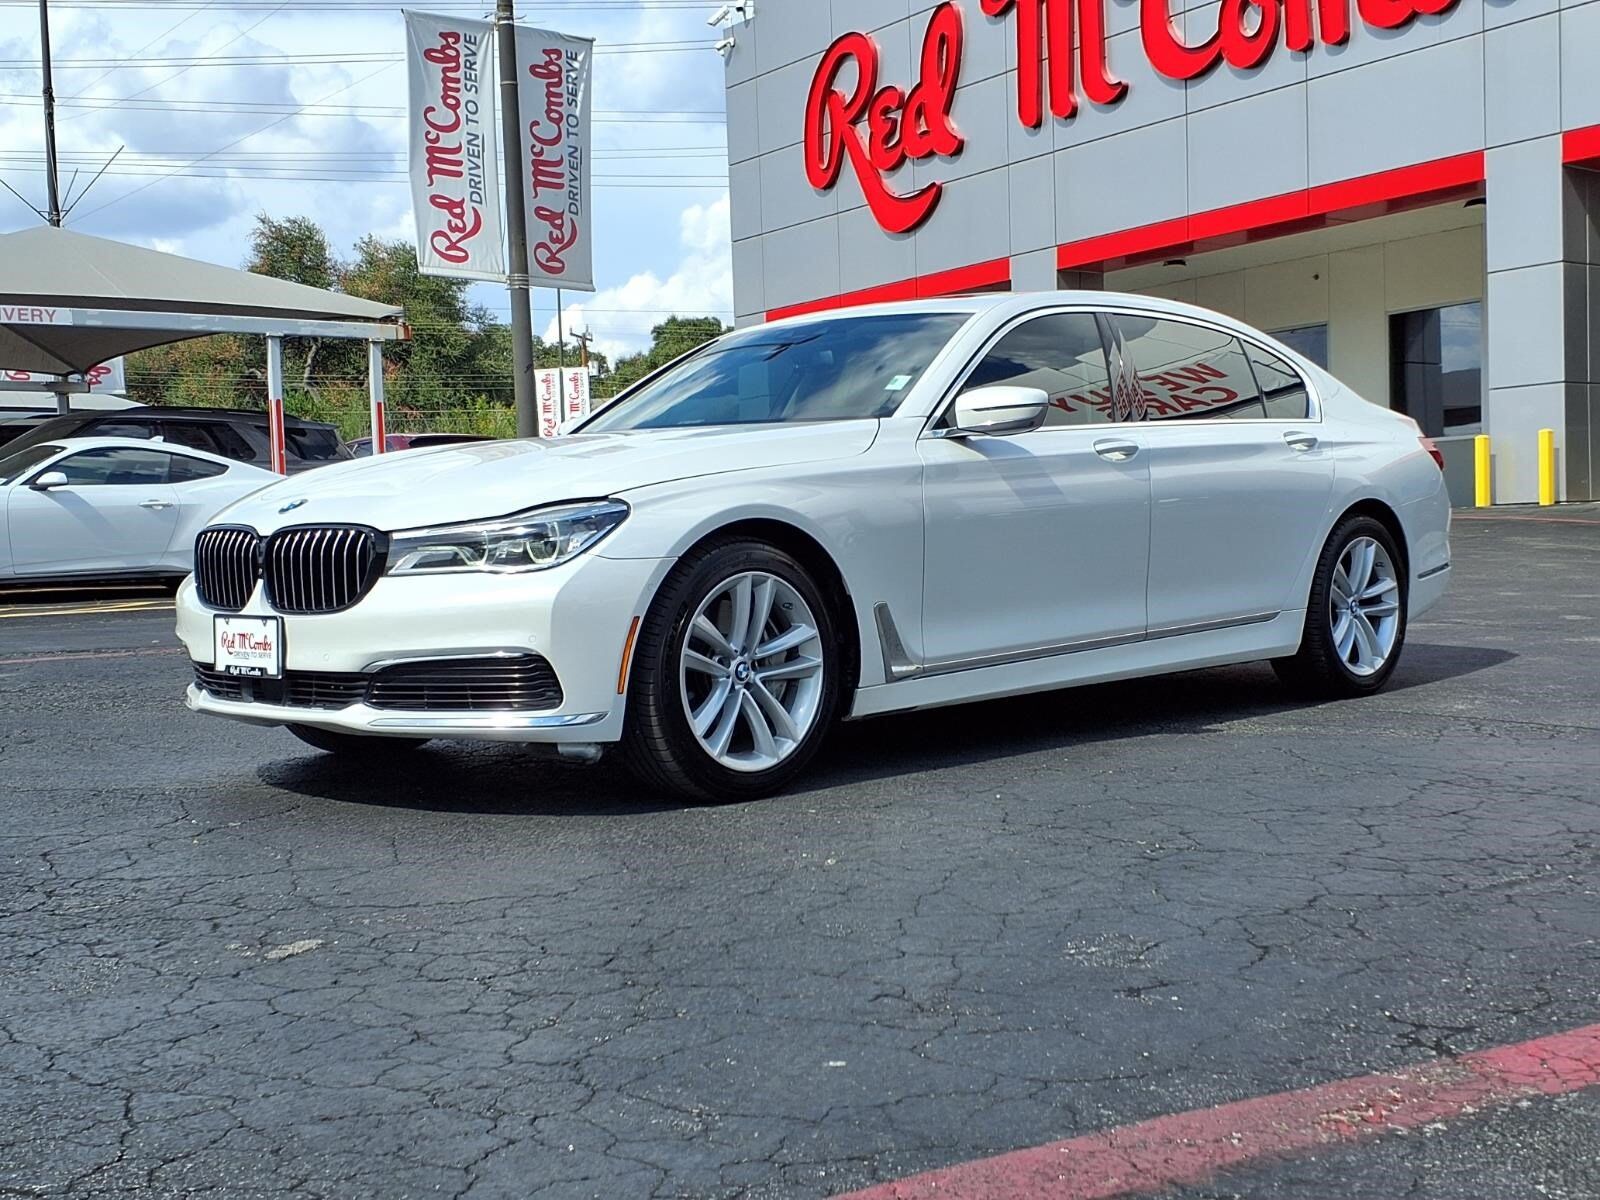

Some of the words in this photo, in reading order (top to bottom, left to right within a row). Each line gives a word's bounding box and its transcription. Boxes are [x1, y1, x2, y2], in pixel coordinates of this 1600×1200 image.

[464, 33, 478, 94] SERVE
[566, 49, 578, 108] SERVE
[424, 32, 463, 187] McCombs
[465, 100, 479, 125] TO
[529, 48, 565, 199] McCombs
[566, 114, 579, 138] TO
[805, 2, 965, 233] Red
[466, 133, 483, 205] DRIVEN
[568, 145, 579, 216] DRIVEN
[429, 194, 482, 263] Red
[533, 206, 577, 274] Red
[221, 631, 235, 655] Red
[237, 632, 272, 651] McCombs
